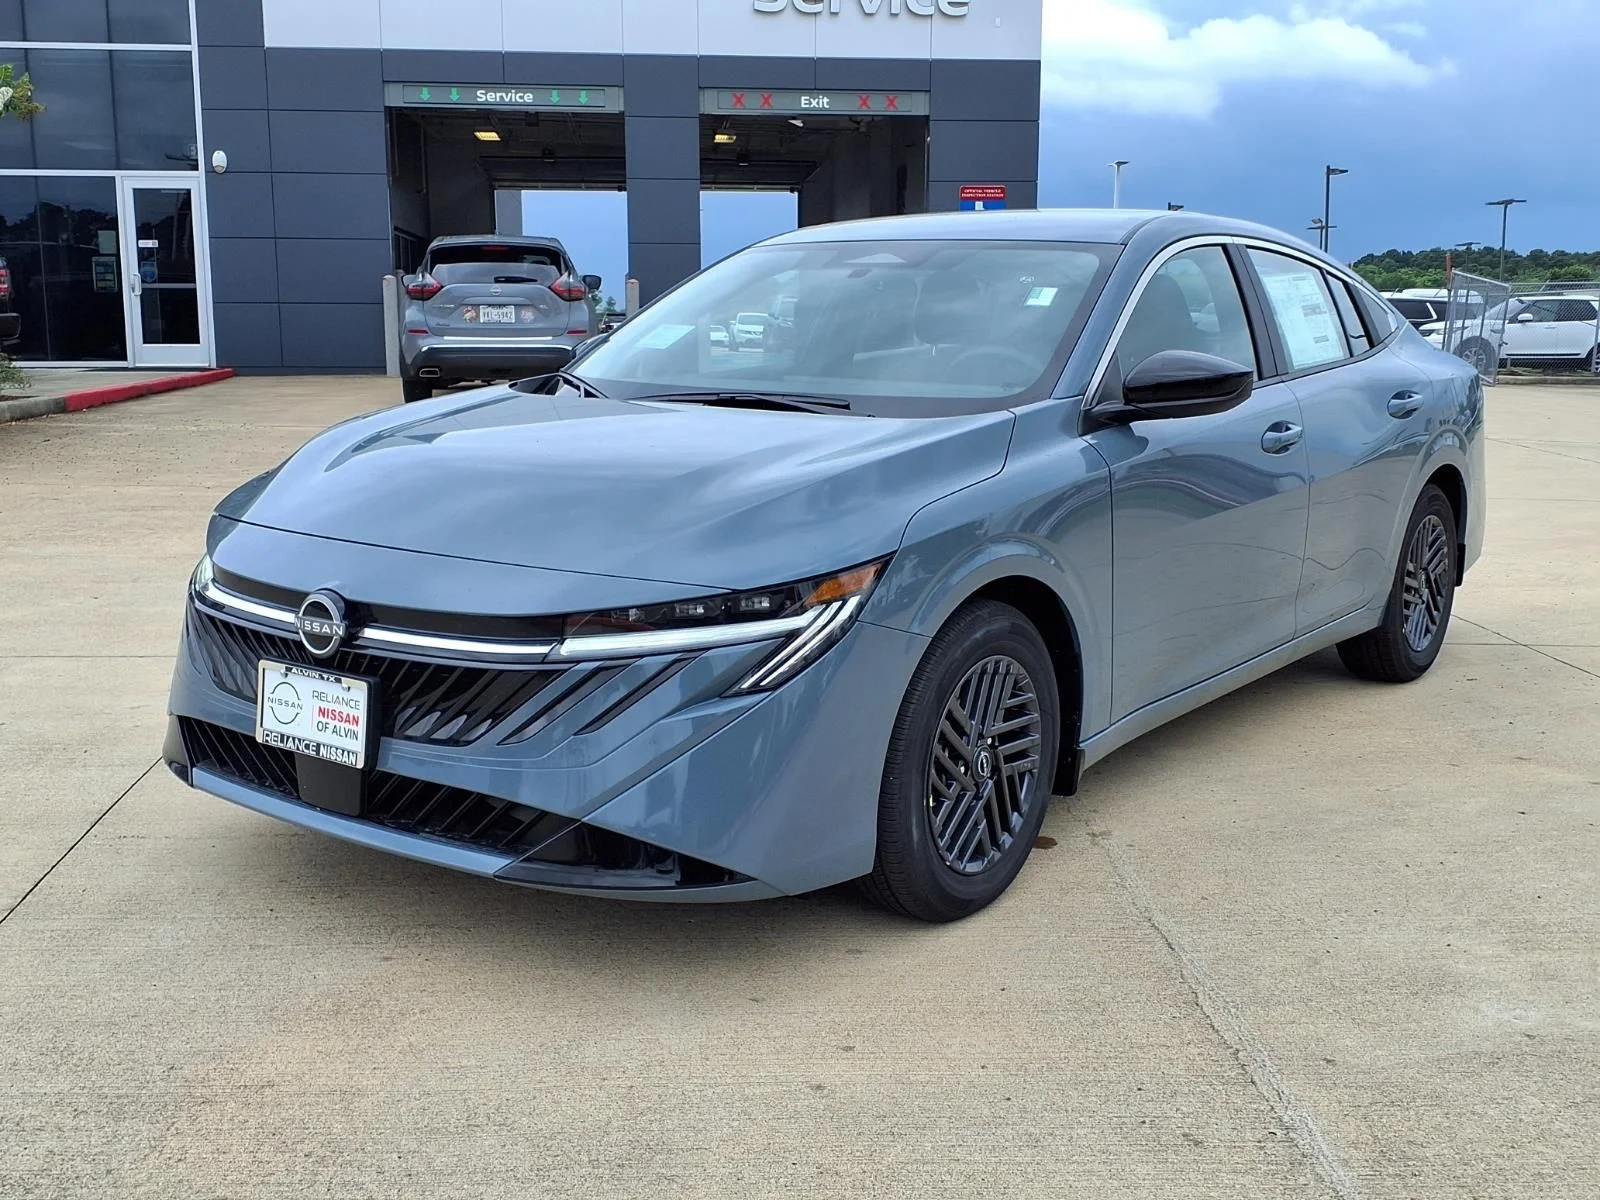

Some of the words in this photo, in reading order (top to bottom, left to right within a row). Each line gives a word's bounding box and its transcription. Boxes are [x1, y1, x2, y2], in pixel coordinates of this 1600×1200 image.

[476, 89, 534, 103] Service
[801, 95, 830, 109] Exit
[294, 617, 344, 636] NISSAN
[322, 674, 336, 683] TX
[267, 696, 303, 710] NISSAN
[312, 689, 361, 711] RELIANCE
[318, 705, 360, 727] NISSAN
[316, 720, 330, 733] OF
[331, 723, 358, 741] ALVIN
[263, 730, 317, 755] RELIANCE
[319, 744, 357, 766] NISSAN
